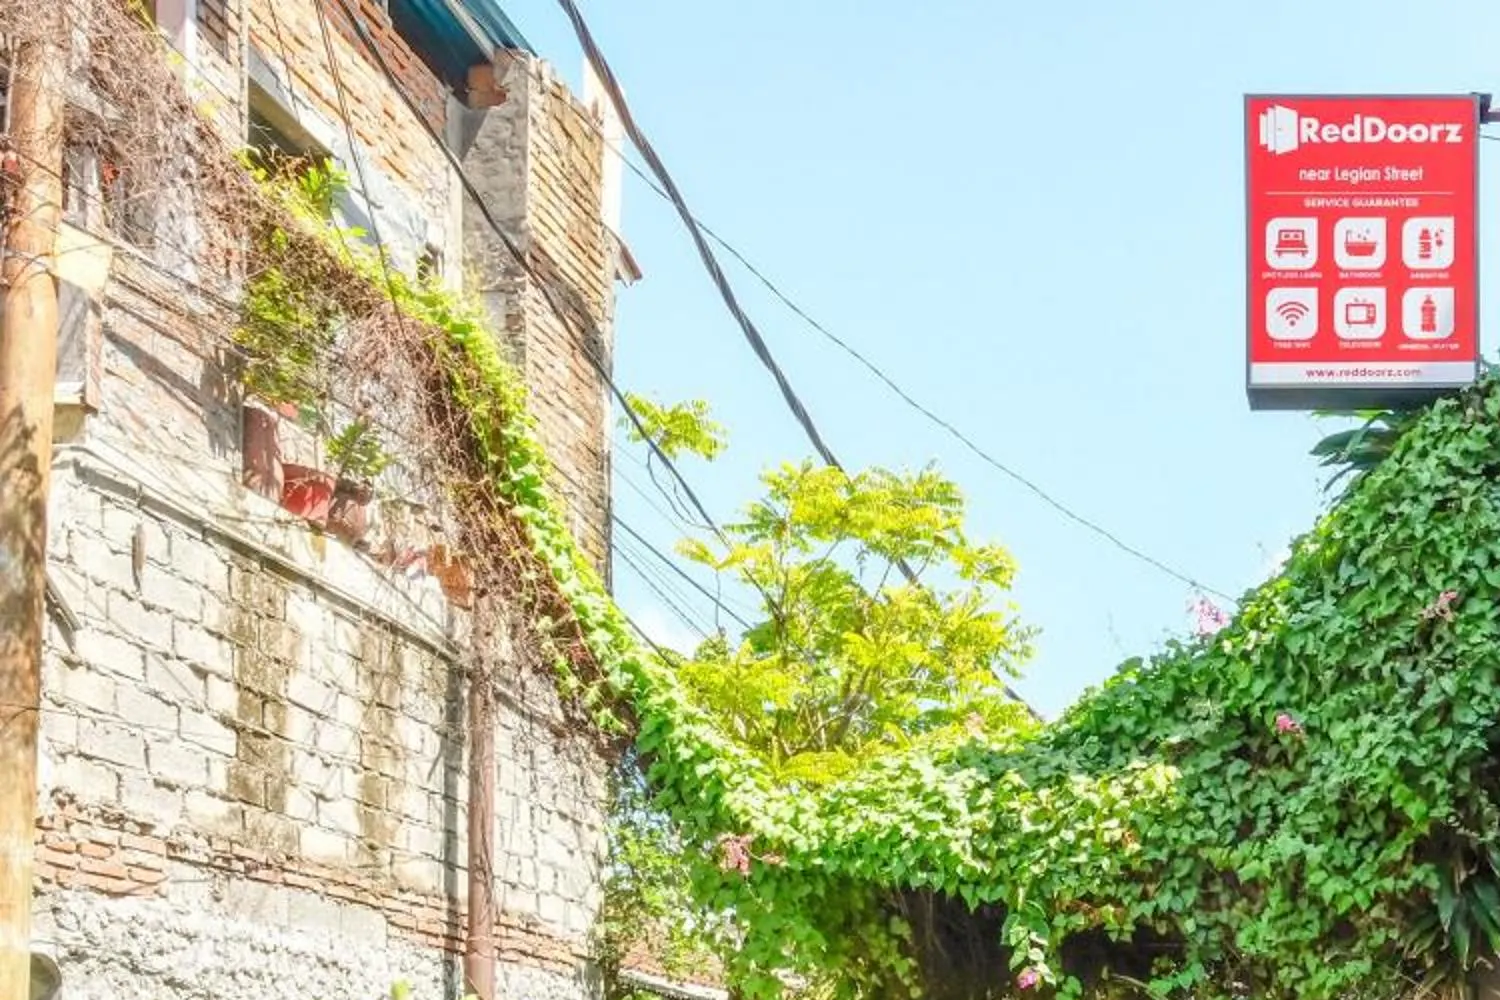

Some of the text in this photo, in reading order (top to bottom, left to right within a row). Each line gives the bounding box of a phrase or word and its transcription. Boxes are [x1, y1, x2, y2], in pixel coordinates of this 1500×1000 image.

[1300, 113, 1463, 143] RedDoorz
[1299, 166, 1423, 185] near Legian Street
[1303, 197, 1419, 208] SERVICE GUARANTEE
[1305, 367, 1423, 378] www.reddoorz.com
